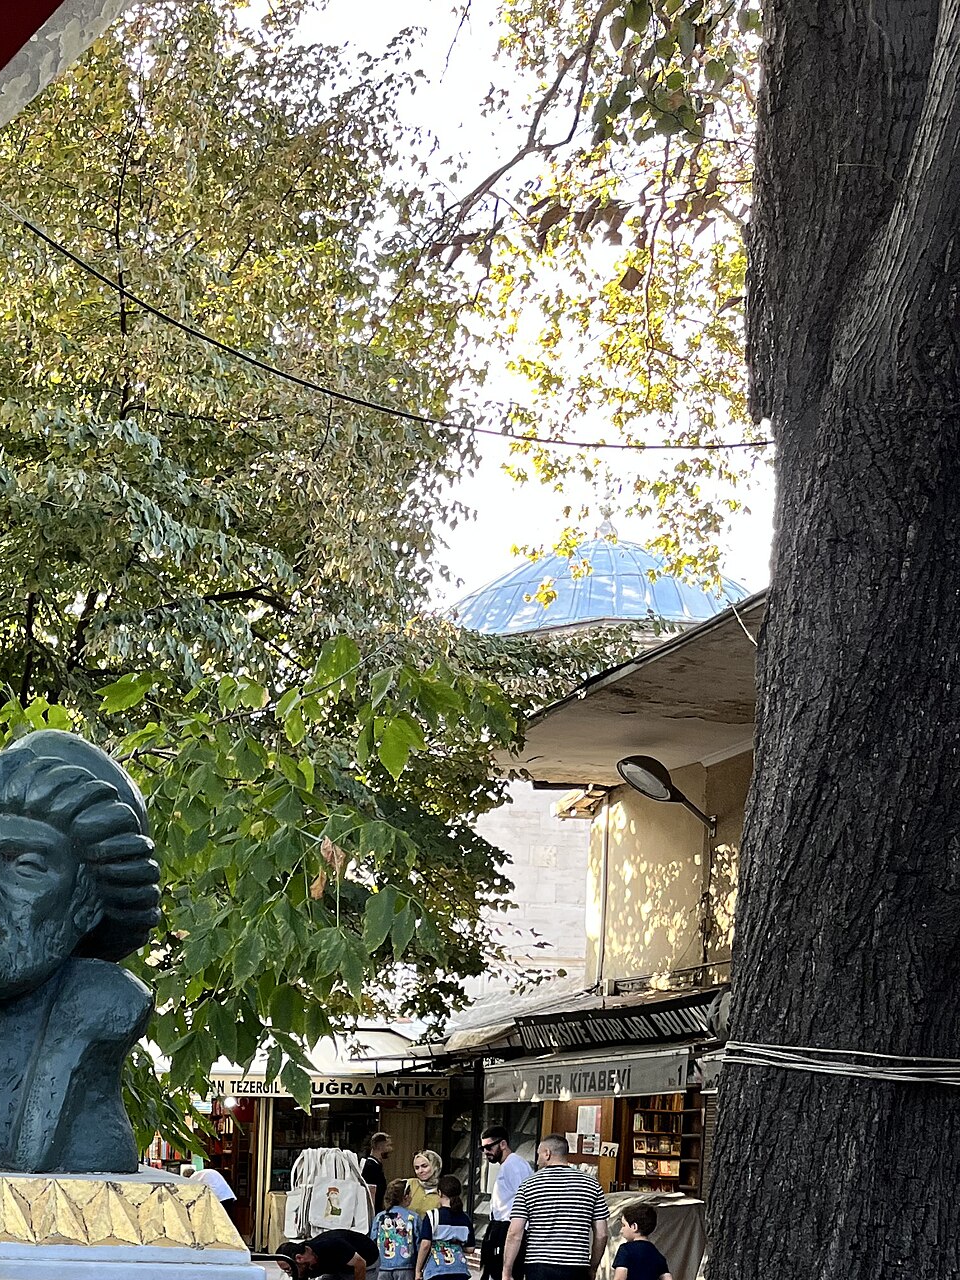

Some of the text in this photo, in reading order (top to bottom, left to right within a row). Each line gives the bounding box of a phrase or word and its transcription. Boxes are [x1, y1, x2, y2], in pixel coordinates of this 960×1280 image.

[520, 1018, 588, 1049] ÜNİVERSİTE
[587, 1014, 654, 1042] KİTAPLARI
[308, 1079, 367, 1096] UĞRA
[372, 1082, 436, 1097] ANTİK
[570, 1065, 632, 1093] KİTABEVİ
[601, 1146, 616, 1157] 26
